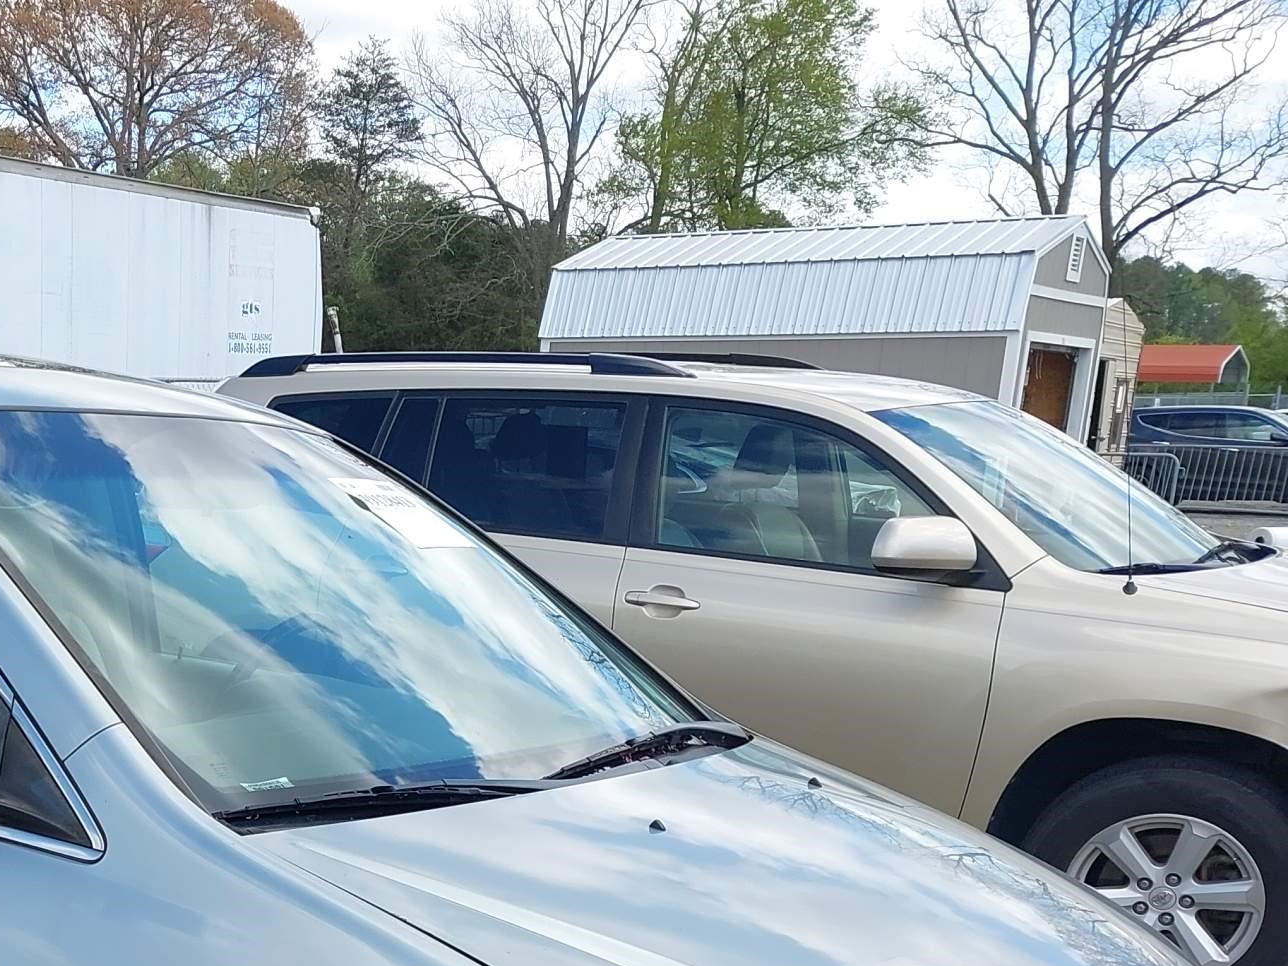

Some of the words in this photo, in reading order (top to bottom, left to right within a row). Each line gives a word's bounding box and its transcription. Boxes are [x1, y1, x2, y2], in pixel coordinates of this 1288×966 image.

[242, 302, 260, 317] gts
[228, 331, 247, 341] RENTAL
[251, 333, 272, 341] LEASING
